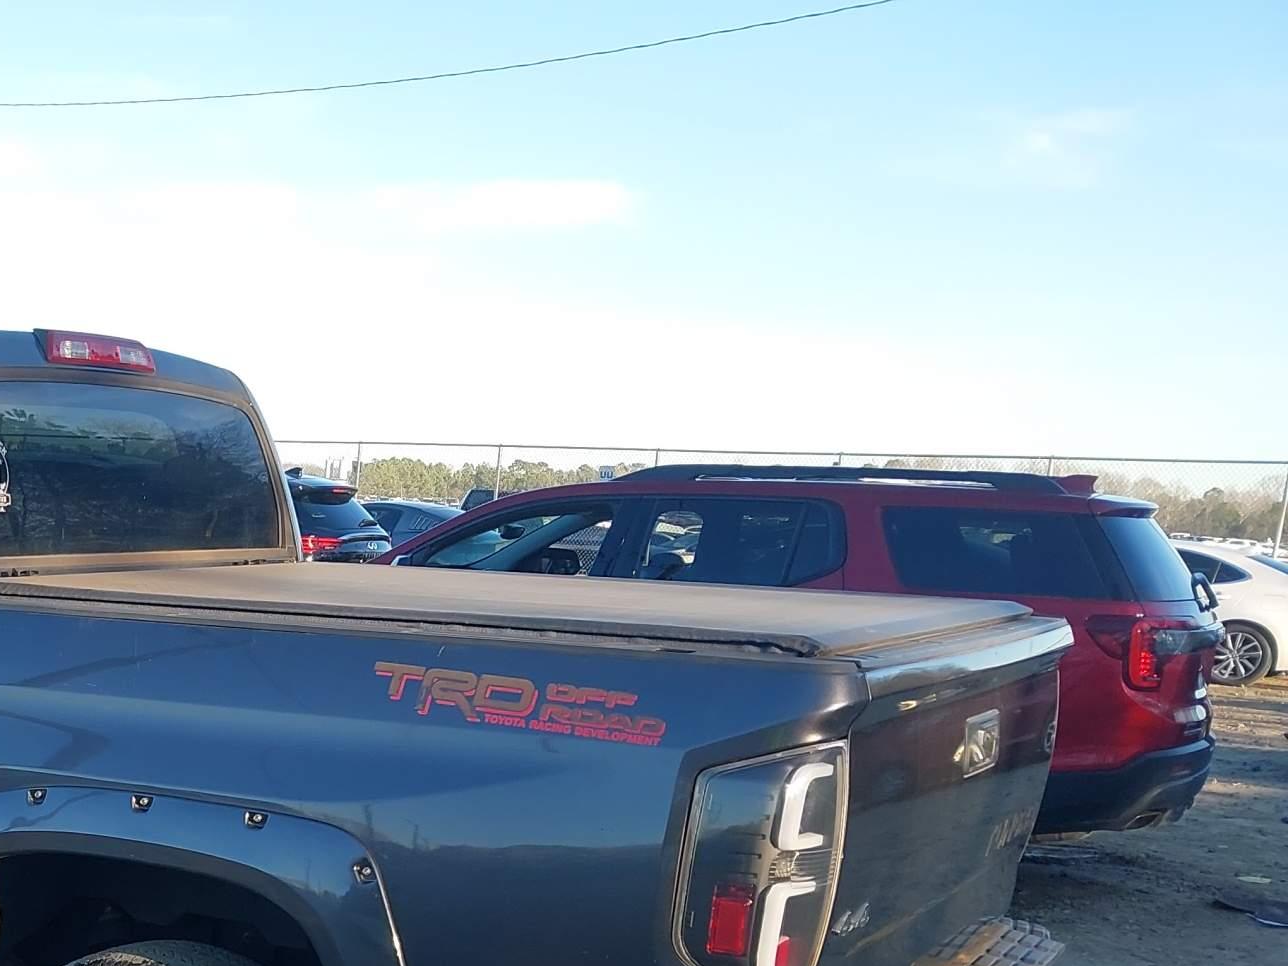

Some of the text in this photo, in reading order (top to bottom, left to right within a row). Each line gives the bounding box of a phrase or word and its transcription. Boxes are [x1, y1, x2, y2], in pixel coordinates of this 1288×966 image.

[374, 661, 538, 722] TRD
[546, 683, 638, 706] OFF
[483, 713, 662, 746] TOYOTA RACING DEVELOPMENT
[539, 703, 666, 737] ROAD
